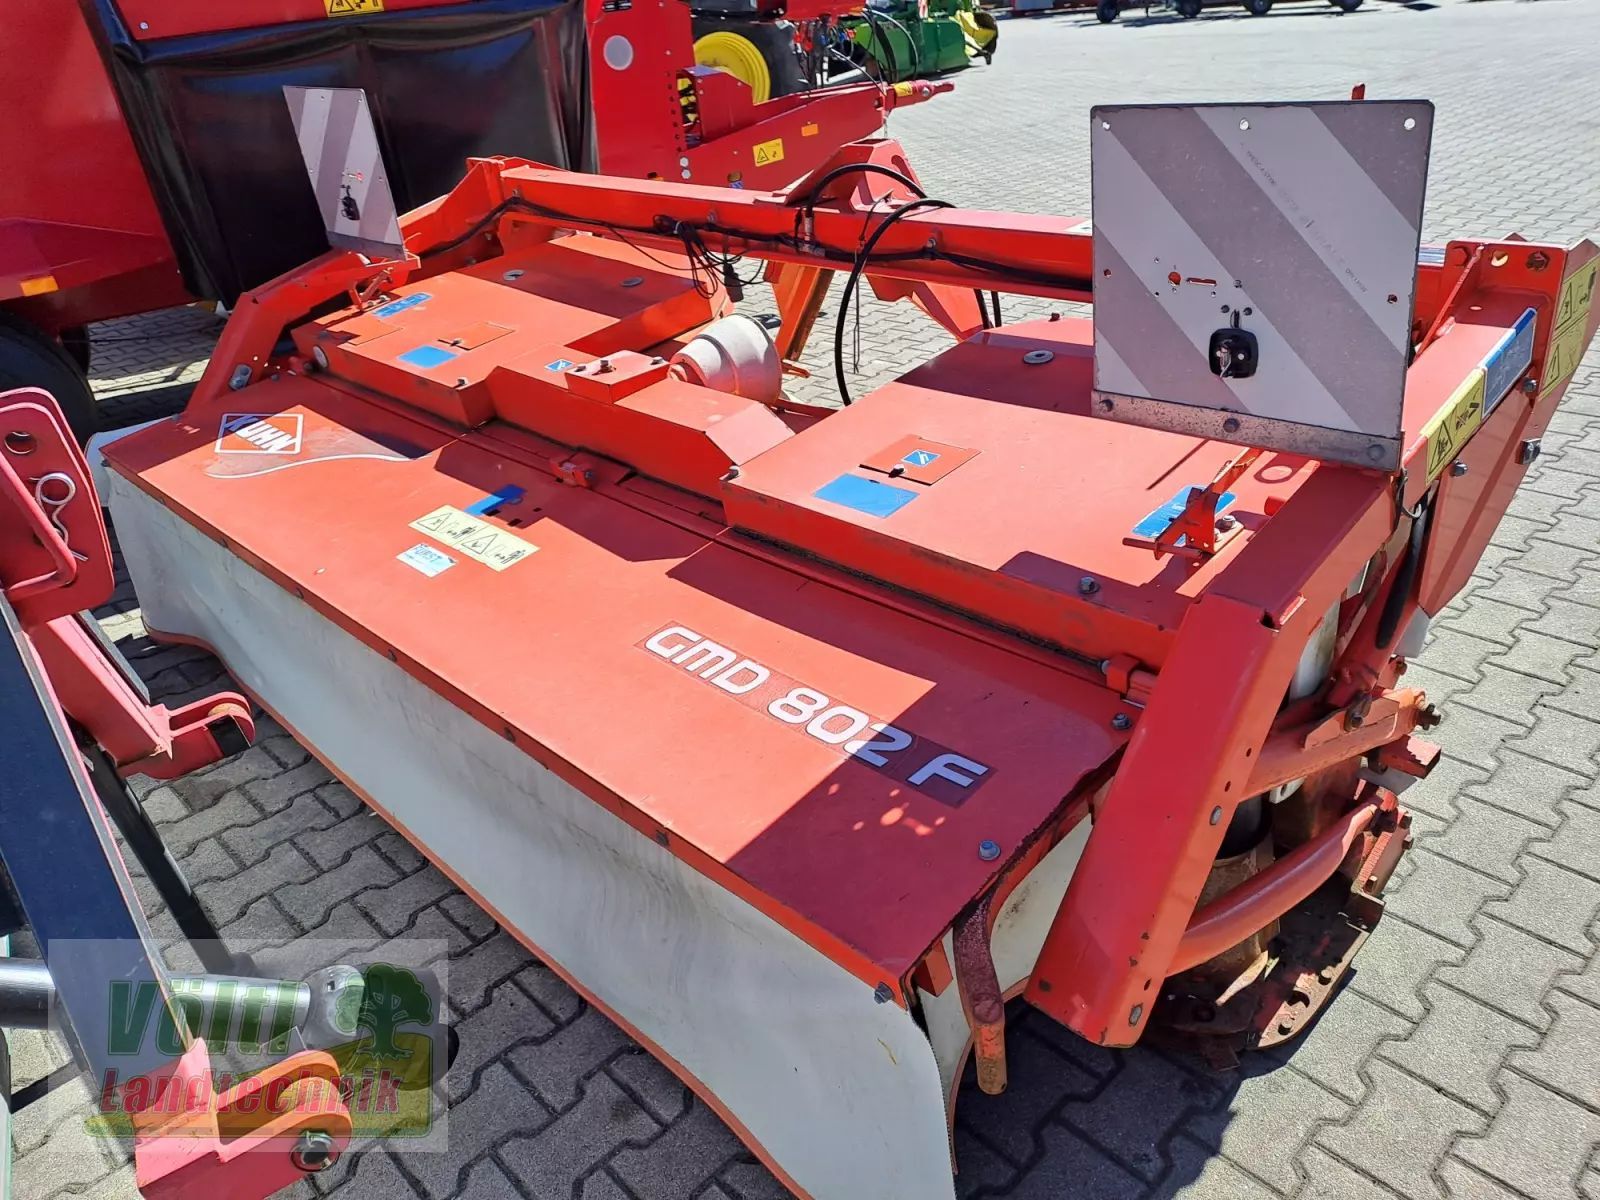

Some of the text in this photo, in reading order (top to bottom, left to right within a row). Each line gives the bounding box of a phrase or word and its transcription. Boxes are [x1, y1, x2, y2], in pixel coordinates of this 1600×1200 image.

[223, 415, 297, 453] KUHN
[644, 625, 989, 788] GMD 802 F
